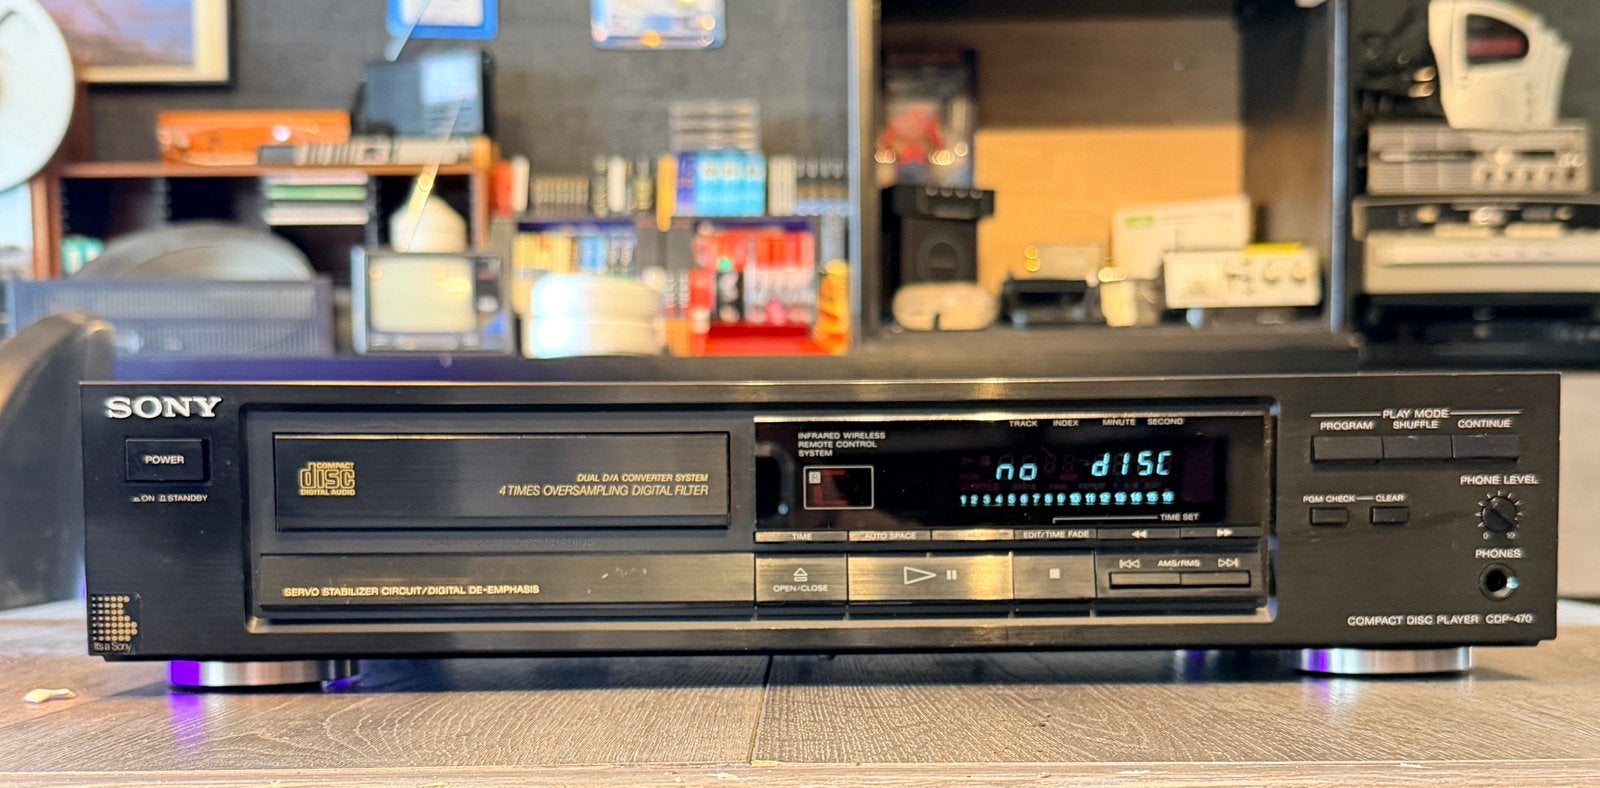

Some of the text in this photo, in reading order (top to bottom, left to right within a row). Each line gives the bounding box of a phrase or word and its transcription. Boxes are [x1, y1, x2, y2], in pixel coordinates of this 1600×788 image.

[105, 396, 222, 419] SONY
[1383, 408, 1449, 420] PLAY MODE
[1009, 417, 1184, 428] TRACK INDEX MINUTE SECOND
[1320, 419, 1513, 431] PROGRAM SHUFFLE CONTINUE
[798, 431, 886, 440] INFRARED WIRELESS
[798, 440, 877, 449] REMOTE CONTROL
[798, 450, 833, 458] SYSTEM
[143, 454, 185, 465] POWER
[576, 473, 708, 482] DUAL D/A CONVERTER SYSTEM
[1459, 475, 1539, 485] PHONE LEVEL
[299, 488, 356, 496] DIGITAL AUDIO
[499, 485, 709, 496] 4 TIMES OVERSAMPLING DIGITAL FILTER
[141, 494, 208, 502] ON STANDBY
[960, 494, 966, 505] 1
[970, 494, 978, 505] 2
[982, 494, 991, 505] 3
[995, 494, 1003, 505] 4
[1032, 493, 1040, 504] 7
[1070, 493, 1081, 503] 10
[1085, 492, 1096, 503] 11
[1100, 492, 1111, 503] 12
[1375, 494, 1405, 503] CLEAR
[1160, 513, 1199, 521] TIME SET
[792, 532, 813, 540] TIME
[864, 531, 917, 539] AUTO SPACE
[1023, 530, 1090, 539] EDIT/TIME FADE
[1483, 531, 1515, 540] 0 10
[1475, 549, 1522, 559] PHONES
[1157, 559, 1201, 568] AMS/RMS
[283, 585, 540, 597] SERVO STABILIZER CIRCUIT/DIGITAL DE-EMPHASIS
[773, 583, 828, 592] OPEN/CLOSE
[1347, 613, 1533, 626] COMPACT DISC PLAYER CDP-470
[111, 641, 132, 653] Sony
